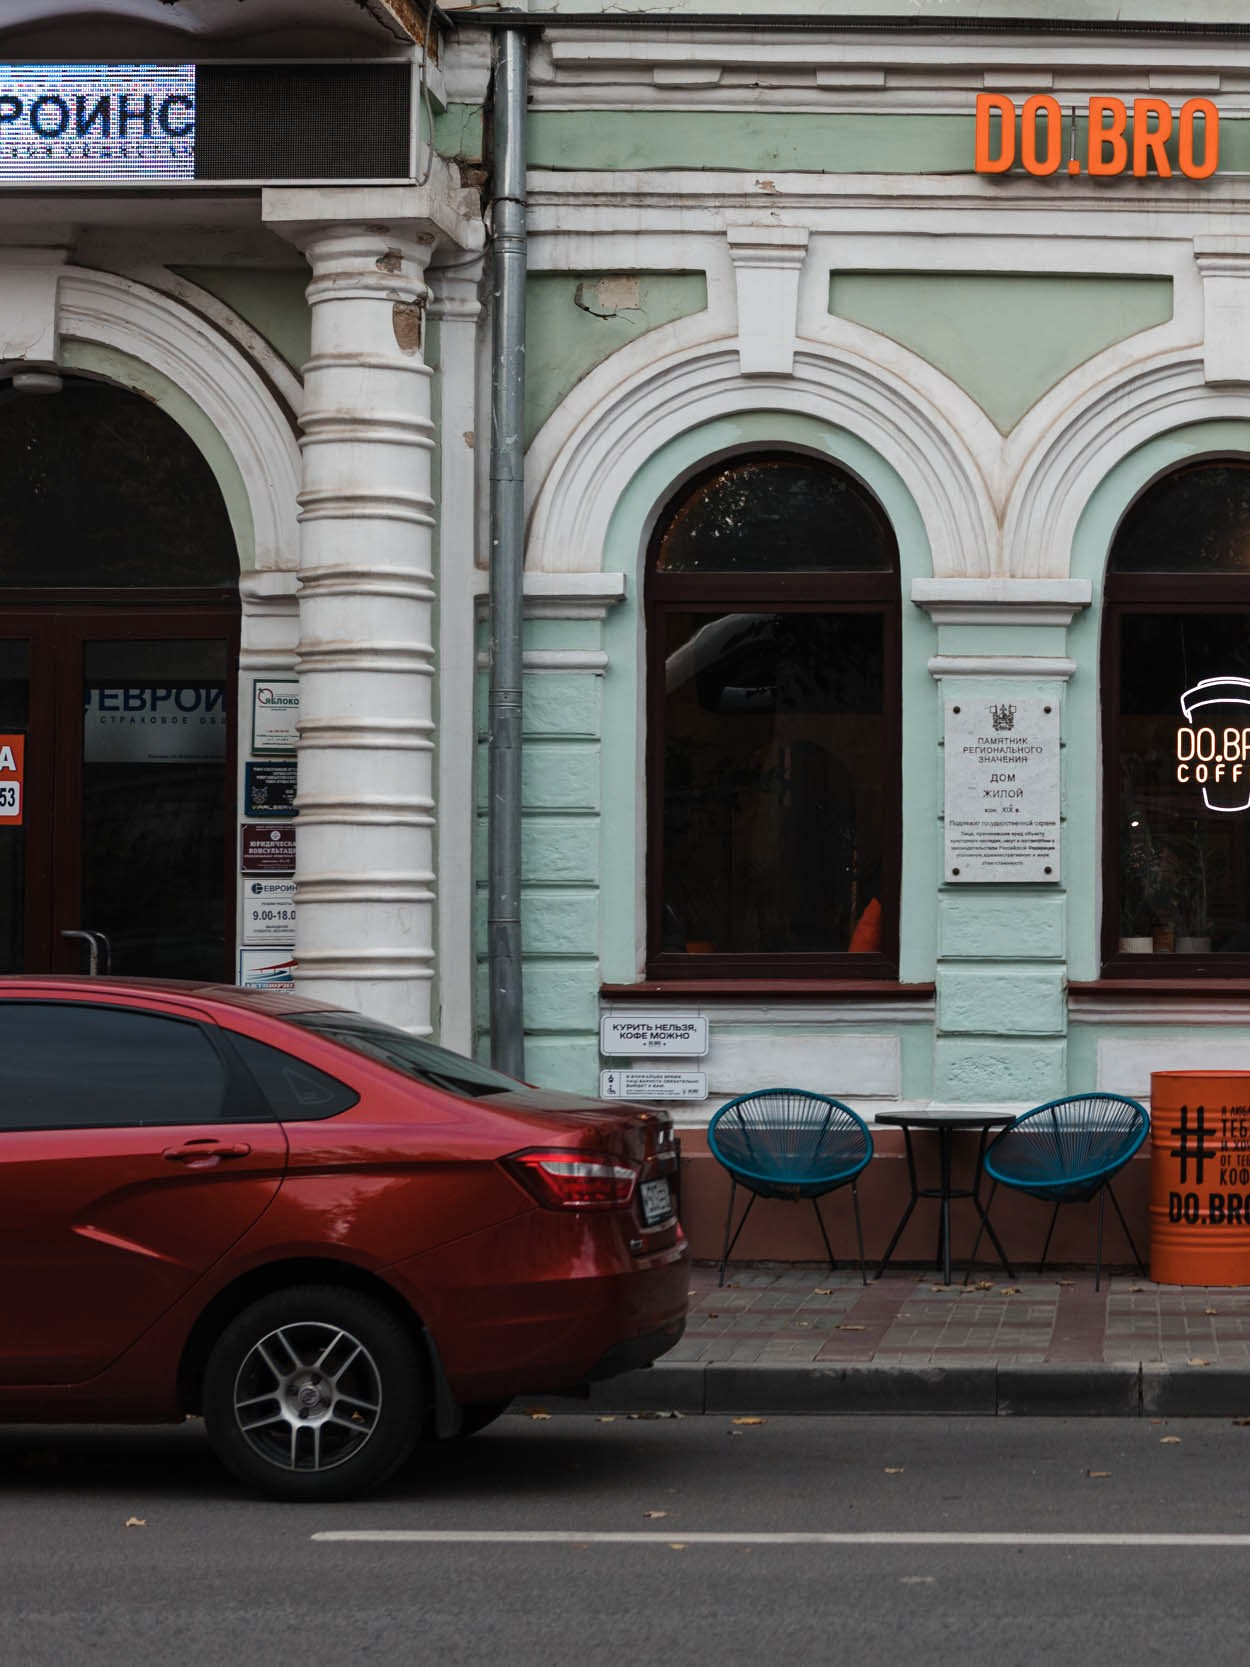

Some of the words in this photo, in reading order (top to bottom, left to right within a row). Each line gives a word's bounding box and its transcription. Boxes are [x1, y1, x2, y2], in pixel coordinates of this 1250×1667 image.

[975, 93, 1219, 179] DO.BRO
[977, 737, 1029, 745] ПАМЯТНИК
[978, 756, 1028, 764] ЗНАЧЕНИЯ
[990, 774, 1016, 783] ДОМ
[983, 788, 1024, 798] ЖИЛОЙ
[612, 1023, 653, 1031] КУРИТЬ
[655, 1023, 697, 1032] НЕЛЬЗЯ,
[619, 1032, 648, 1040] КОФЕ
[650, 1032, 690, 1040] МОЖНО
[1220, 1155, 1231, 1167] ОТ
